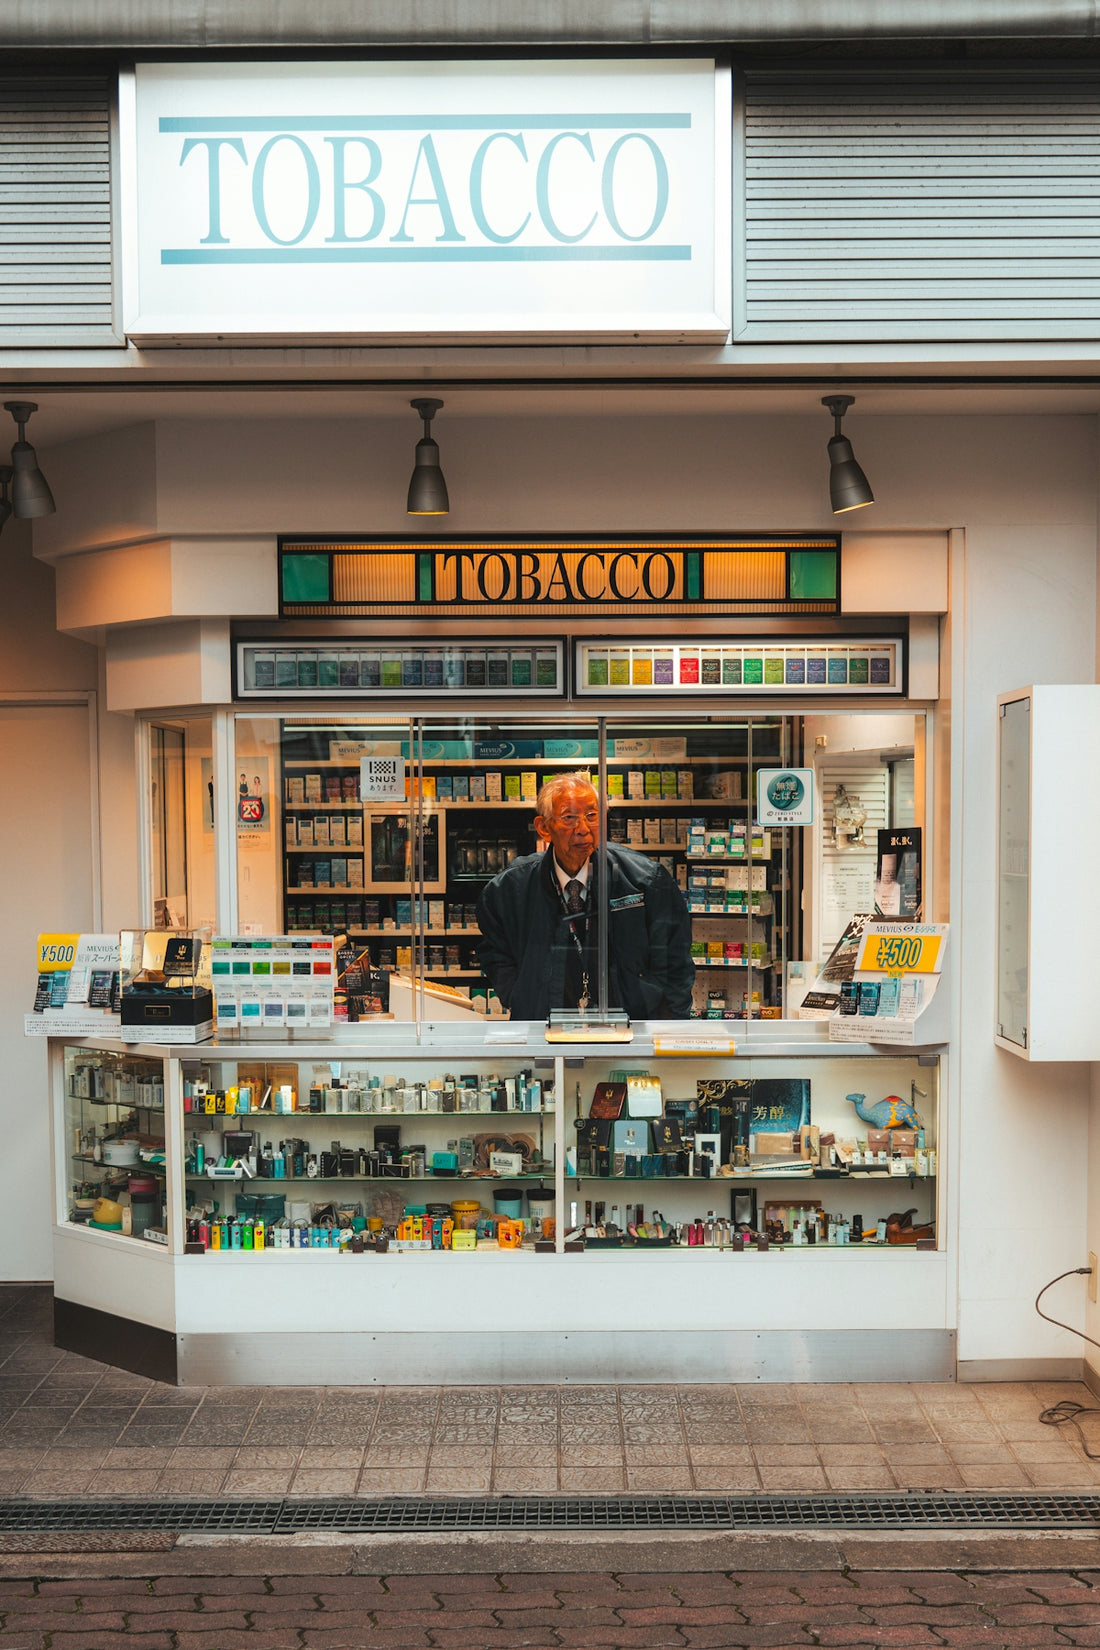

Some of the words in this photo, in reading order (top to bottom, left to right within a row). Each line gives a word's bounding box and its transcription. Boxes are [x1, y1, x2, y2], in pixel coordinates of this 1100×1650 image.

[179, 131, 670, 247] TOBACCO
[443, 552, 676, 601] TOBACCO
[369, 775, 397, 783] SNUS
[771, 791, 800, 800] たばこ
[242, 805, 261, 818] 20
[876, 925, 902, 933] MEVIUS
[41, 945, 74, 962] ¥500
[876, 937, 923, 968] ¥500
[752, 1106, 792, 1120] 芳醇。
